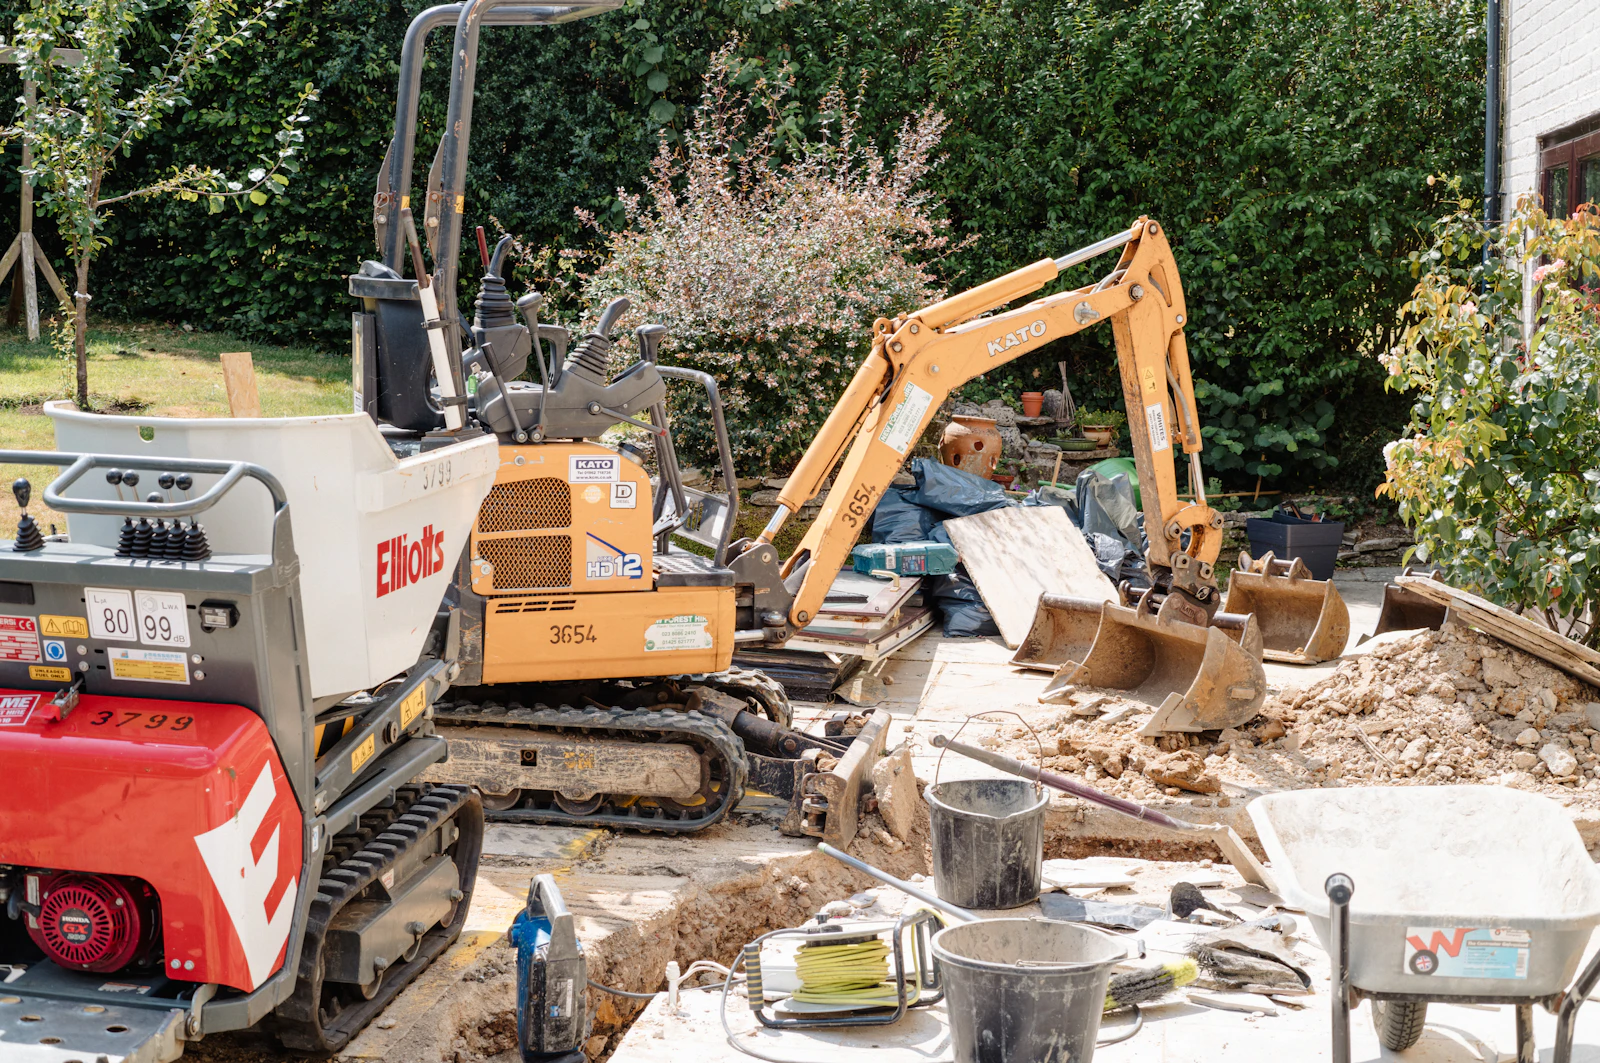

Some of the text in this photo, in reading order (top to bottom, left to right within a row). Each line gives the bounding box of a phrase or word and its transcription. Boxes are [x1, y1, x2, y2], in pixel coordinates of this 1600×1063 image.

[986, 319, 1047, 357] KATO
[423, 460, 452, 490] 3799
[577, 460, 612, 469] KATO
[841, 482, 876, 528] 3654
[376, 524, 445, 599] Elliotts
[586, 553, 643, 579] HD12
[103, 607, 129, 635] 80
[144, 614, 172, 641] 99
[173, 635, 186, 643] dB
[549, 624, 598, 645] 3654
[90, 710, 194, 732] 3799
[61, 916, 90, 924] HONDA
[62, 923, 89, 935] GX
